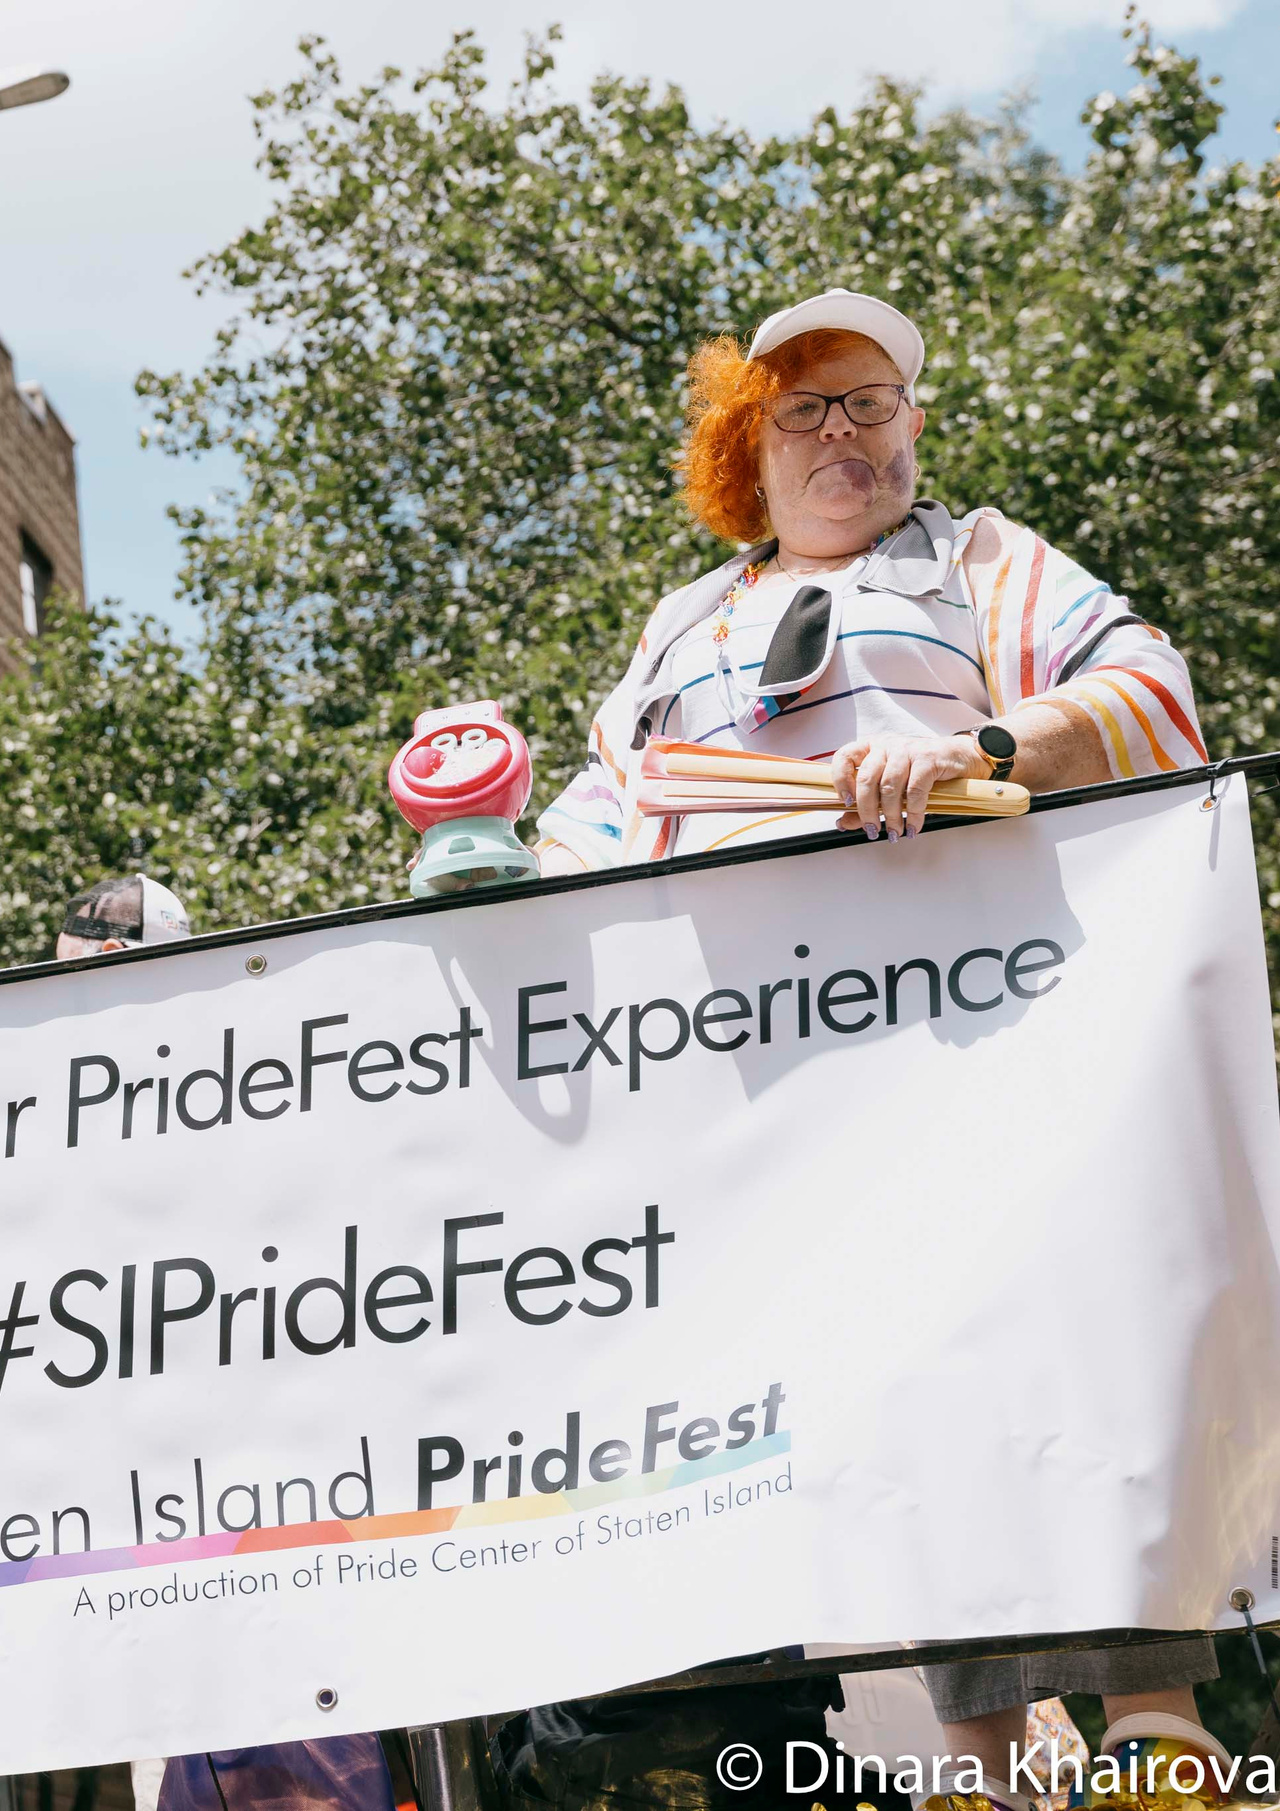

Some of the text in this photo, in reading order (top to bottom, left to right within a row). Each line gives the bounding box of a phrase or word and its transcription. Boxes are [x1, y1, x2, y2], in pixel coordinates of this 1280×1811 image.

[67, 1007, 483, 1148] PrideFest
[517, 939, 1065, 1092] Experience
[73, 1461, 793, 1620] A production of Pride Center of Staten Island
[131, 1435, 375, 1546] Island
[417, 1382, 786, 1512] PrideFest
